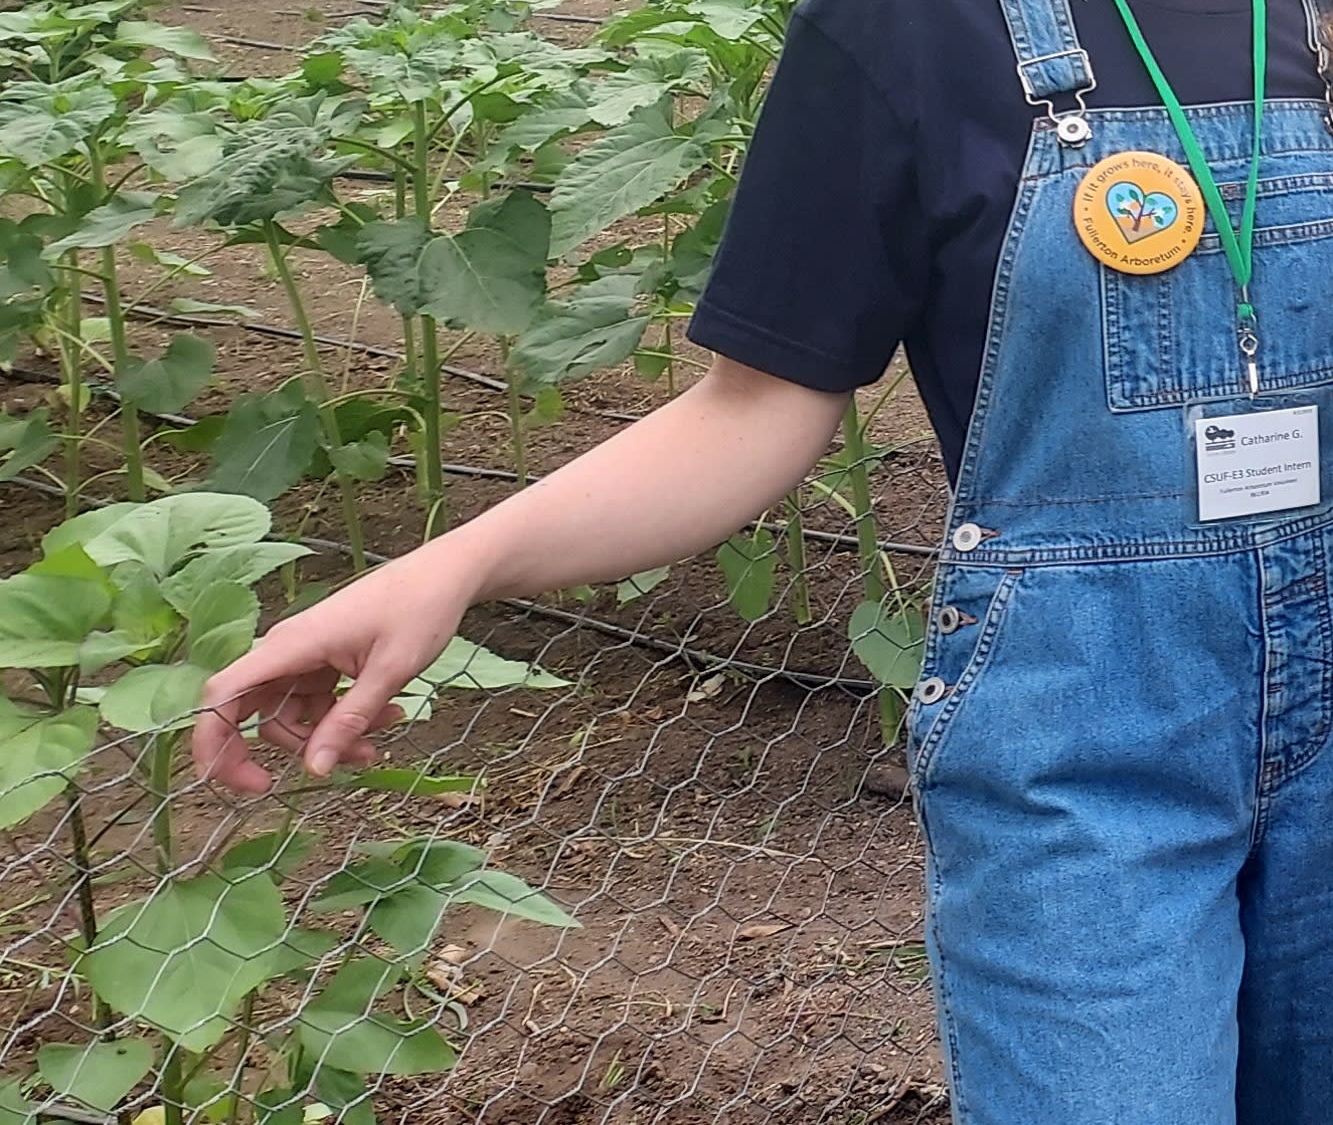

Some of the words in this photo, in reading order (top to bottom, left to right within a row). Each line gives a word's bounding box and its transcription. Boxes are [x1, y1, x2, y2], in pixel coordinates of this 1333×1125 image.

[1083, 193, 1093, 202] If
[1089, 183, 1099, 192] it
[1097, 161, 1129, 183] grows
[1132, 158, 1161, 174] here,
[1164, 167, 1174, 178] it
[1174, 177, 1192, 204] stays
[1184, 207, 1197, 234] here.
[1083, 217, 1118, 260] Fullerton
[1120, 245, 1181, 266] Arboretum
[1241, 432, 1290, 446] Catharine
[1292, 429, 1303, 439] G.
[1204, 469, 1244, 483] CSUF-E3
[1246, 465, 1282, 477] Student
[1284, 461, 1312, 471] Intern
